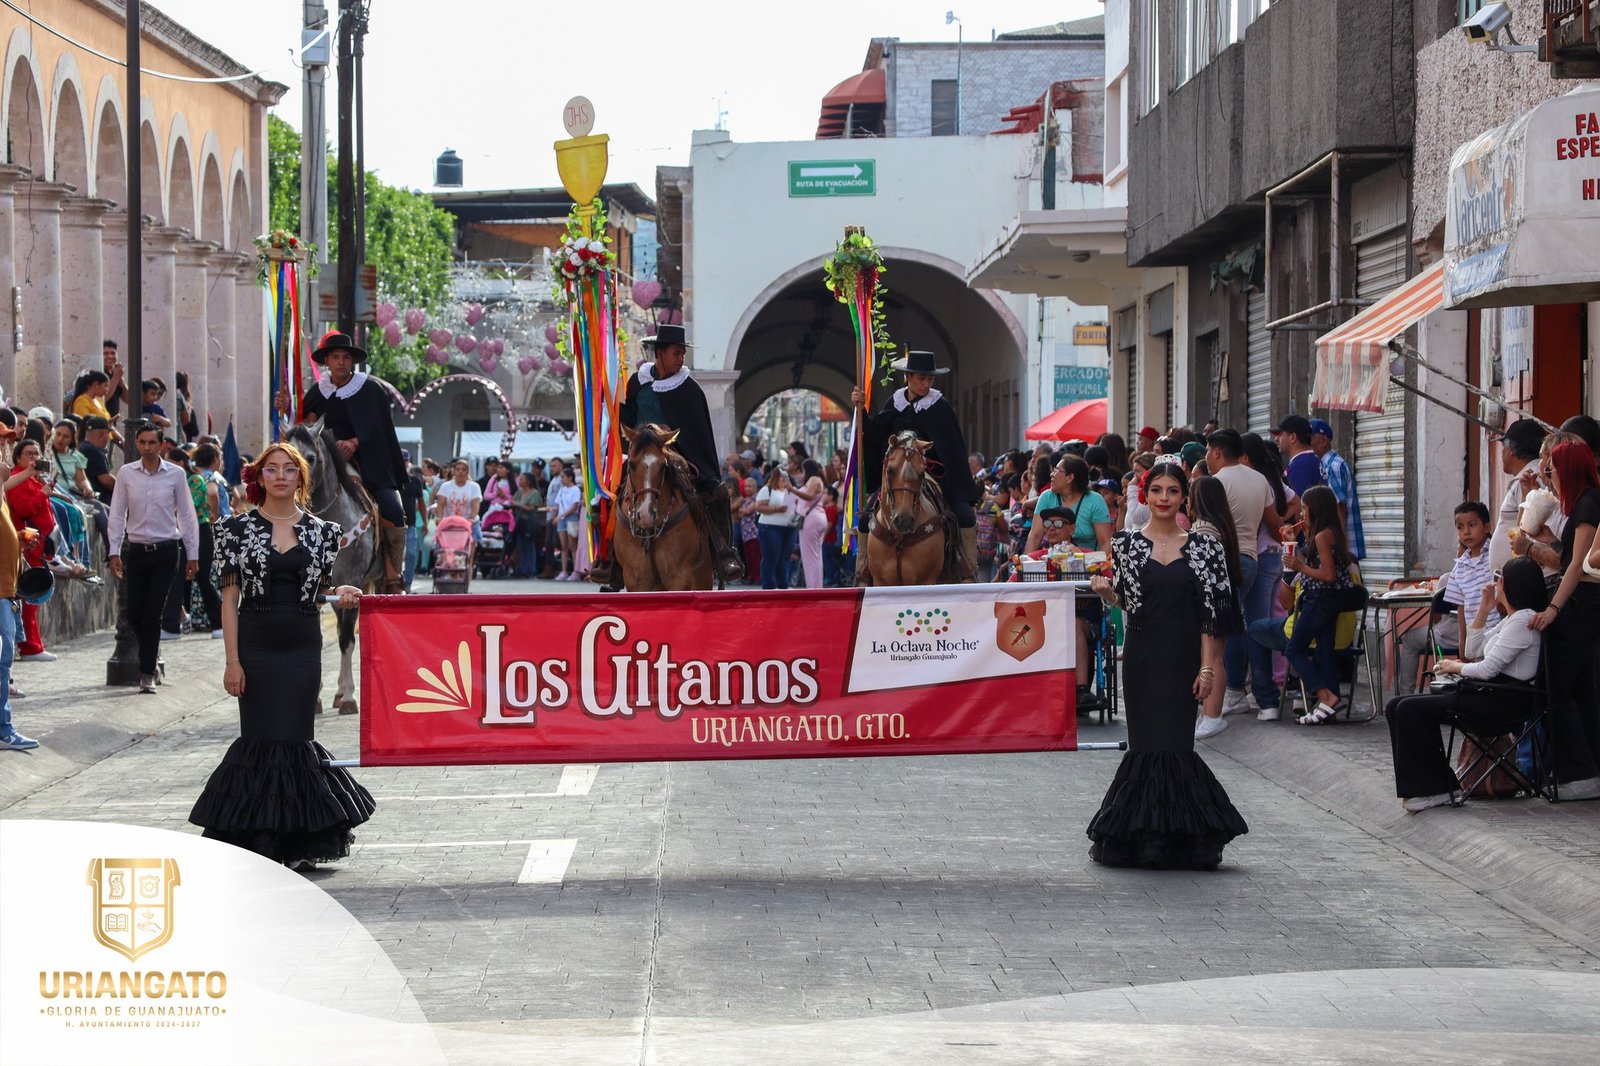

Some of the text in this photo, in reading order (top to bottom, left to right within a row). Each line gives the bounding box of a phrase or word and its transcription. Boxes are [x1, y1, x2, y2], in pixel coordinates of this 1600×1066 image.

[567, 104, 588, 127] JHS
[825, 179, 868, 187] EVACUACIÓN
[1056, 383, 1102, 395] MUNICIPAL
[871, 640, 887, 654] La
[891, 639, 932, 653] Octava
[890, 652, 958, 662] Uriangato Guanajuato
[480, 615, 819, 724] Los Gitanos
[691, 713, 911, 747] URIANGATO, GTO.
